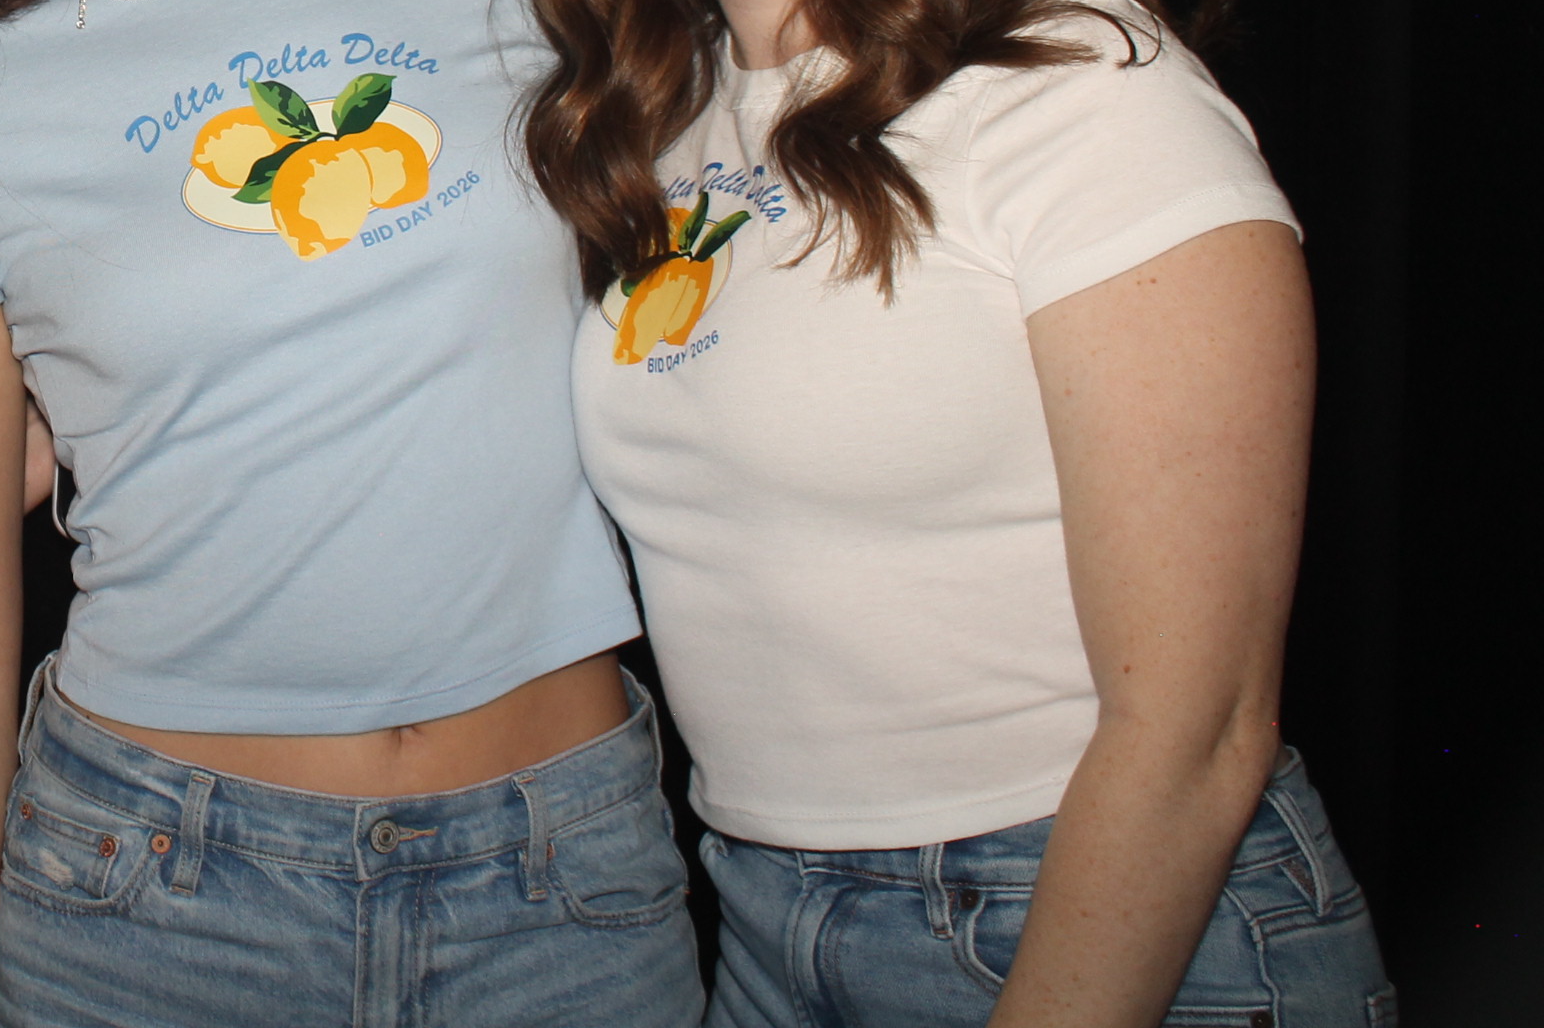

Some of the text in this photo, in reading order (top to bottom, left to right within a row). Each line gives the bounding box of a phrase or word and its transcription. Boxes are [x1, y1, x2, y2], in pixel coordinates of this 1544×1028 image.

[125, 33, 440, 153] Delta Delta Delta
[360, 171, 480, 248] BID DAY 2026
[661, 176, 696, 200] lta
[647, 330, 719, 373] BID DAY 2026
